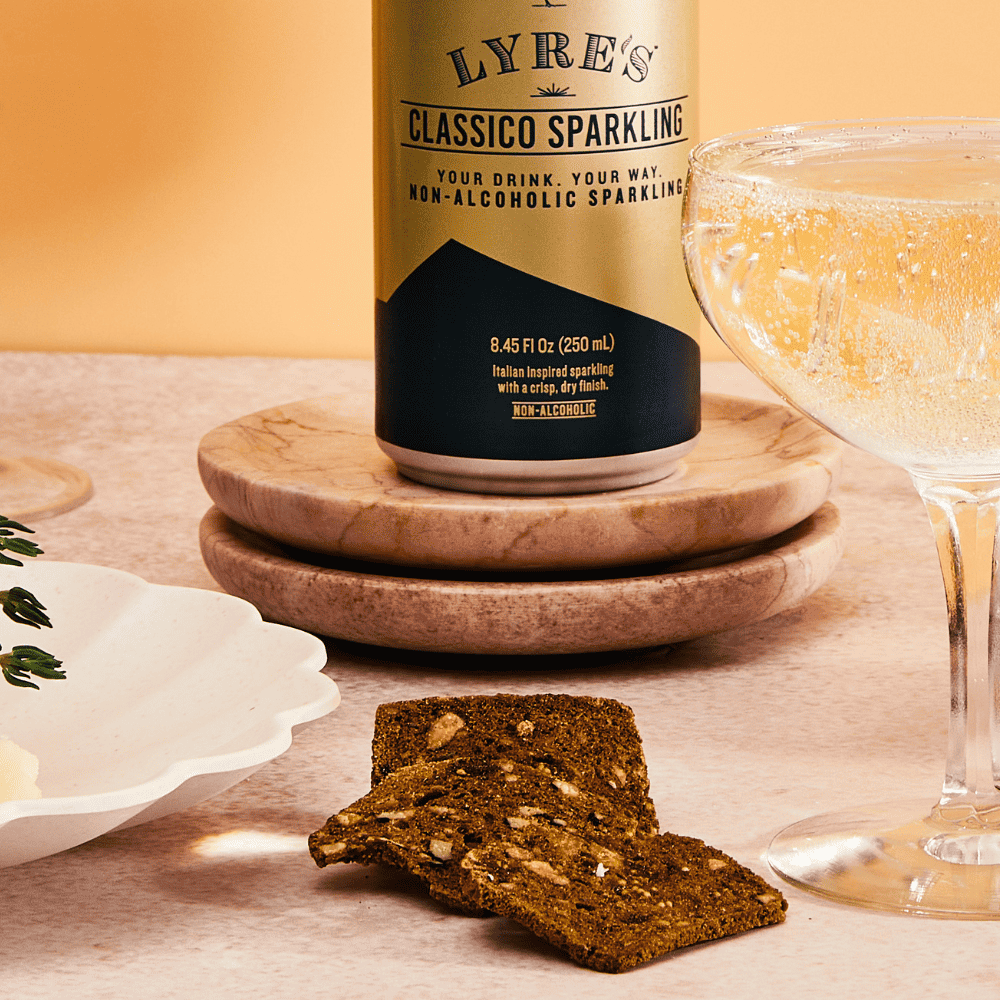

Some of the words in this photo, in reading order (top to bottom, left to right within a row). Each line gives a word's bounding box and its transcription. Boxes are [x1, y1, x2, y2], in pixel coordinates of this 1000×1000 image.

[446, 31, 659, 88] LYRE'S
[409, 108, 536, 149] CLASSICO
[548, 104, 683, 149] SPARKLING
[437, 169, 484, 186] YOUR
[493, 173, 561, 187] DRINK.
[572, 170, 620, 186] YOUR
[628, 165, 663, 181] WAY.
[409, 184, 576, 208] NON-ALCOHOLIC
[588, 178, 683, 207] SPARKLING
[490, 337, 520, 354] 8.45
[537, 338, 555, 354] Oz
[558, 336, 589, 356] (250
[592, 333, 615, 353] mL)
[492, 364, 525, 379] Italian
[526, 365, 568, 381] inspired
[569, 363, 614, 380] sparkling
[498, 380, 520, 394] with
[521, 383, 528, 394] a
[530, 380, 559, 396] crisp,
[560, 379, 577, 395] dry
[579, 378, 609, 392] finish.
[512, 402, 597, 417] NON-ALCOHOLIC
